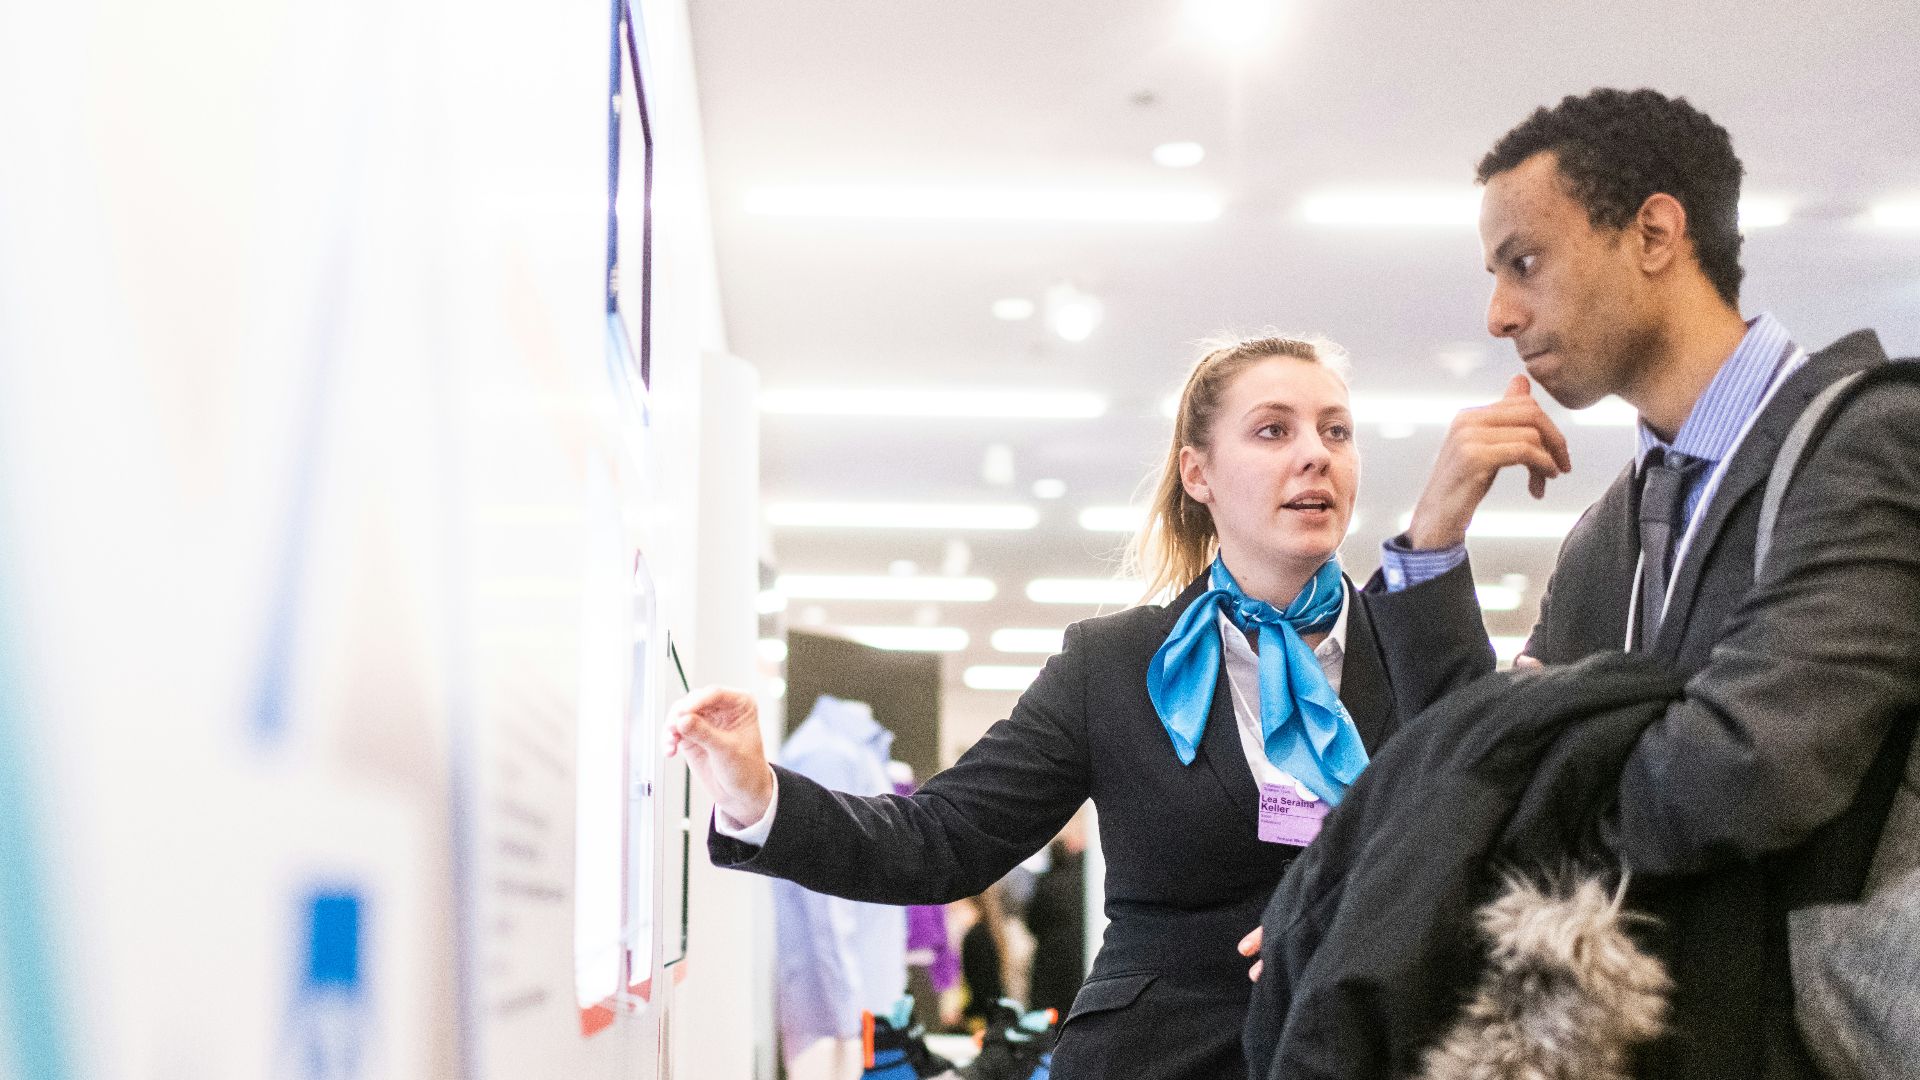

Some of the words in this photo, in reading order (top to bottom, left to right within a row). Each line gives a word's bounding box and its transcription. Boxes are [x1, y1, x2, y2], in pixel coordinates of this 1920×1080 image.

[1261, 795, 1278, 803] Lea
[1280, 797, 1315, 809] Seraina
[1261, 803, 1290, 813] Keller
